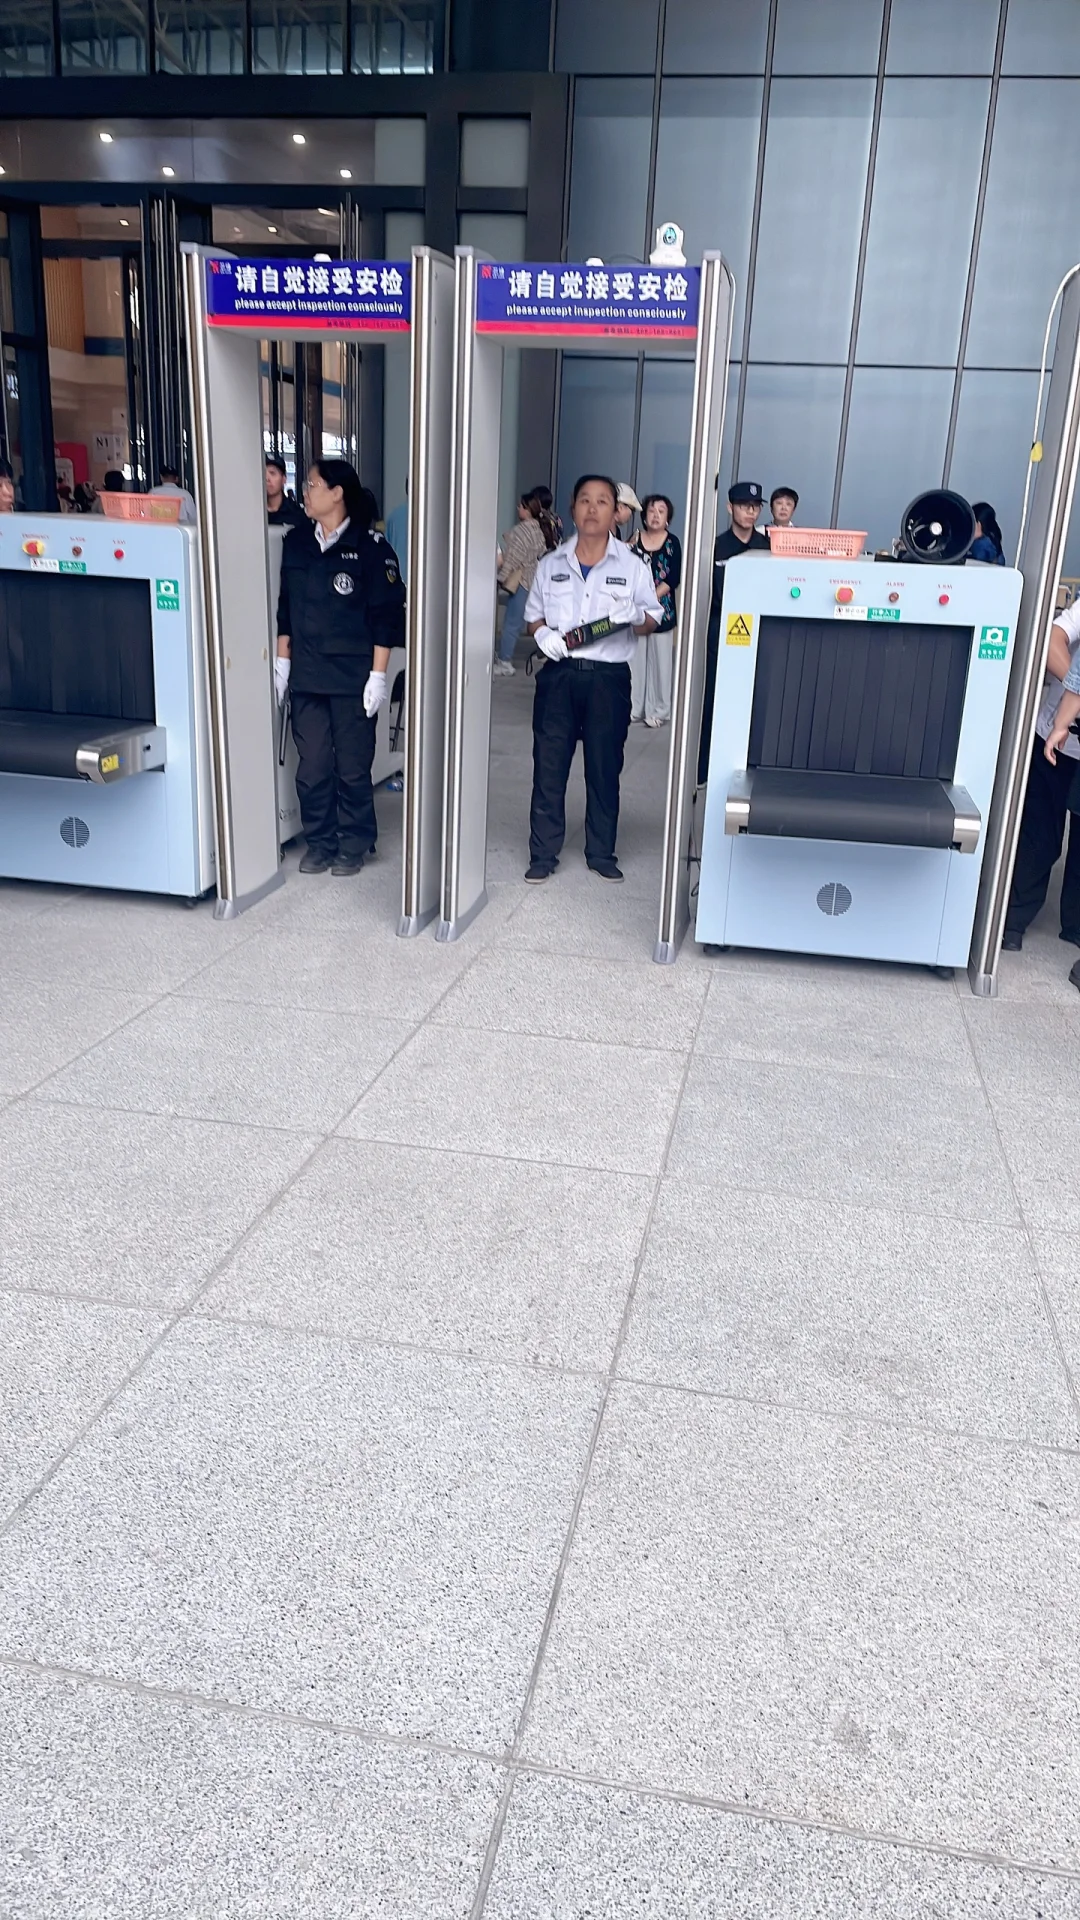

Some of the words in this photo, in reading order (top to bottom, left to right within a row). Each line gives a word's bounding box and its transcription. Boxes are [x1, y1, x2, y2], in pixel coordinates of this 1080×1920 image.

[235, 265, 403, 296] 请自觉接受安检
[508, 269, 689, 302] 请自觉接受安检
[235, 298, 264, 310] please
[266, 300, 297, 312] accept
[298, 299, 347, 313] inspection
[348, 301, 403, 315] consciously
[506, 304, 538, 316] please
[540, 306, 572, 317] accept
[574, 305, 625, 318] inspection
[627, 307, 687, 320] consciously
